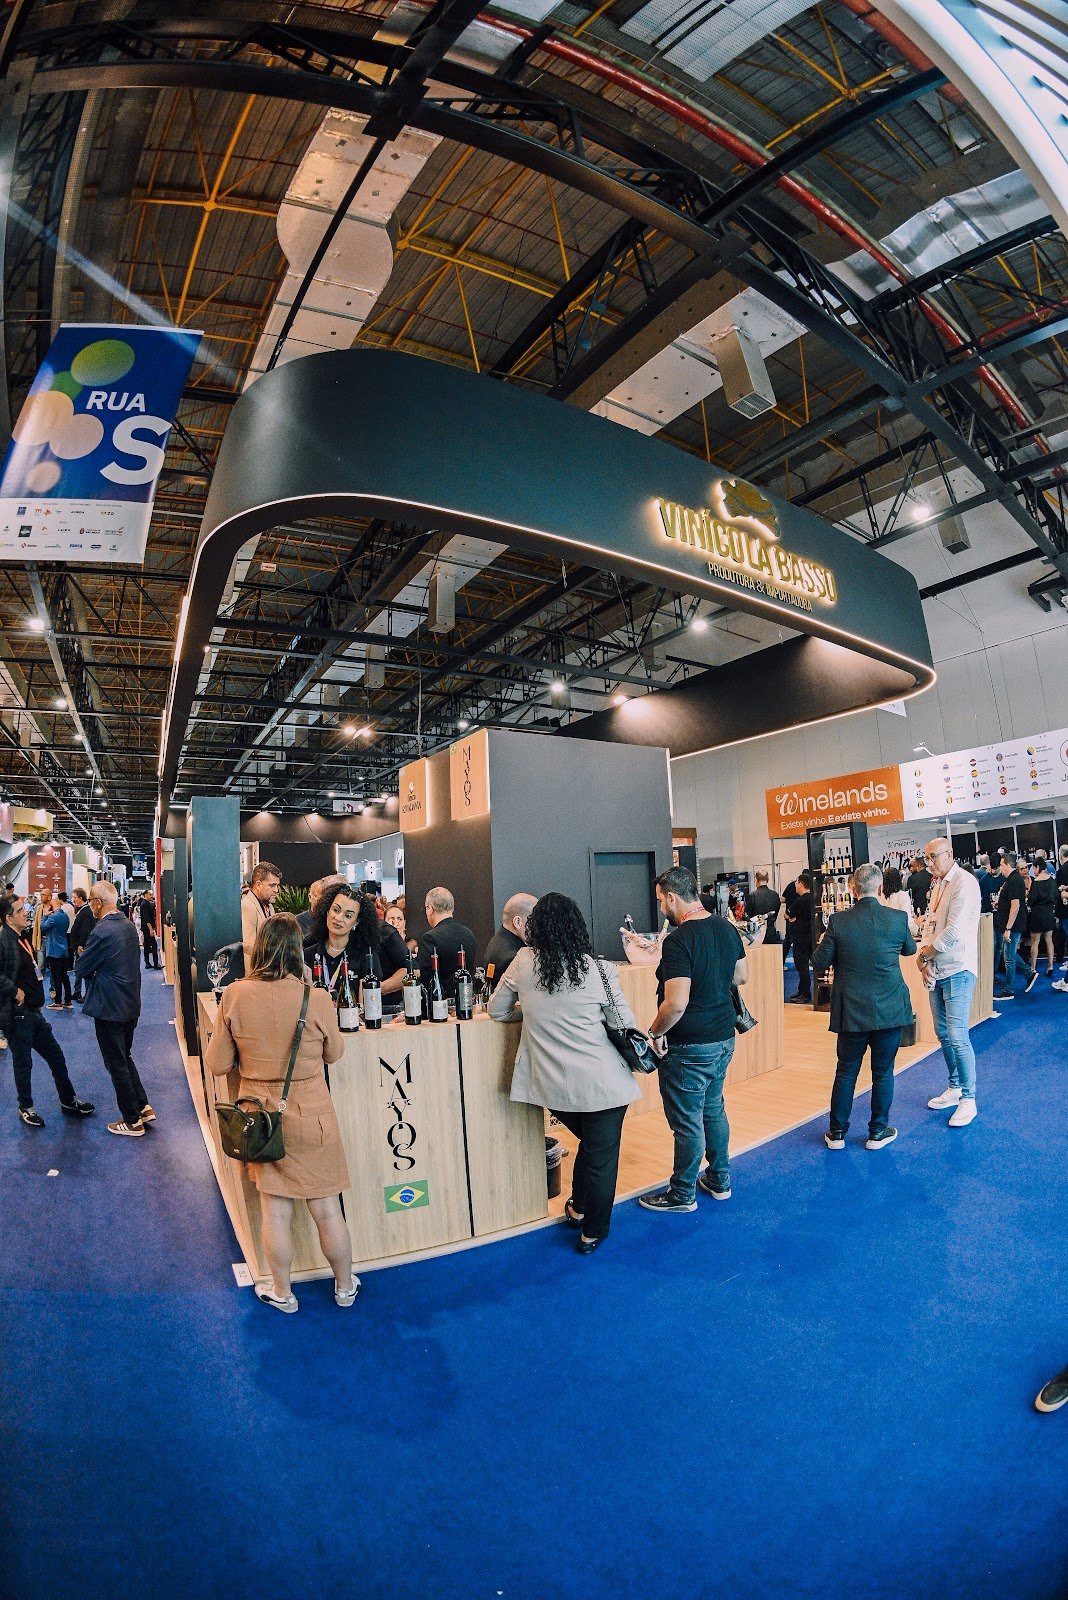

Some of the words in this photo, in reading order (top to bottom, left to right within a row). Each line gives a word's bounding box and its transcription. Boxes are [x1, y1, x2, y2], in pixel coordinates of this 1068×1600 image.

[86, 390, 146, 412] RUA
[100, 415, 173, 485] S
[658, 497, 774, 576] VINÍCOLA
[774, 545, 838, 602] BASSO
[706, 560, 756, 591] PRODUTORA
[756, 579, 766, 595] &
[765, 583, 813, 612] IMPORTADORA
[775, 780, 889, 817] Winelands
[780, 820, 804, 830] Existe
[828, 814, 834, 823] E
[834, 811, 862, 823] existe
[862, 807, 890, 818] vinho.
[377, 1052, 417, 1171] MAYOS
